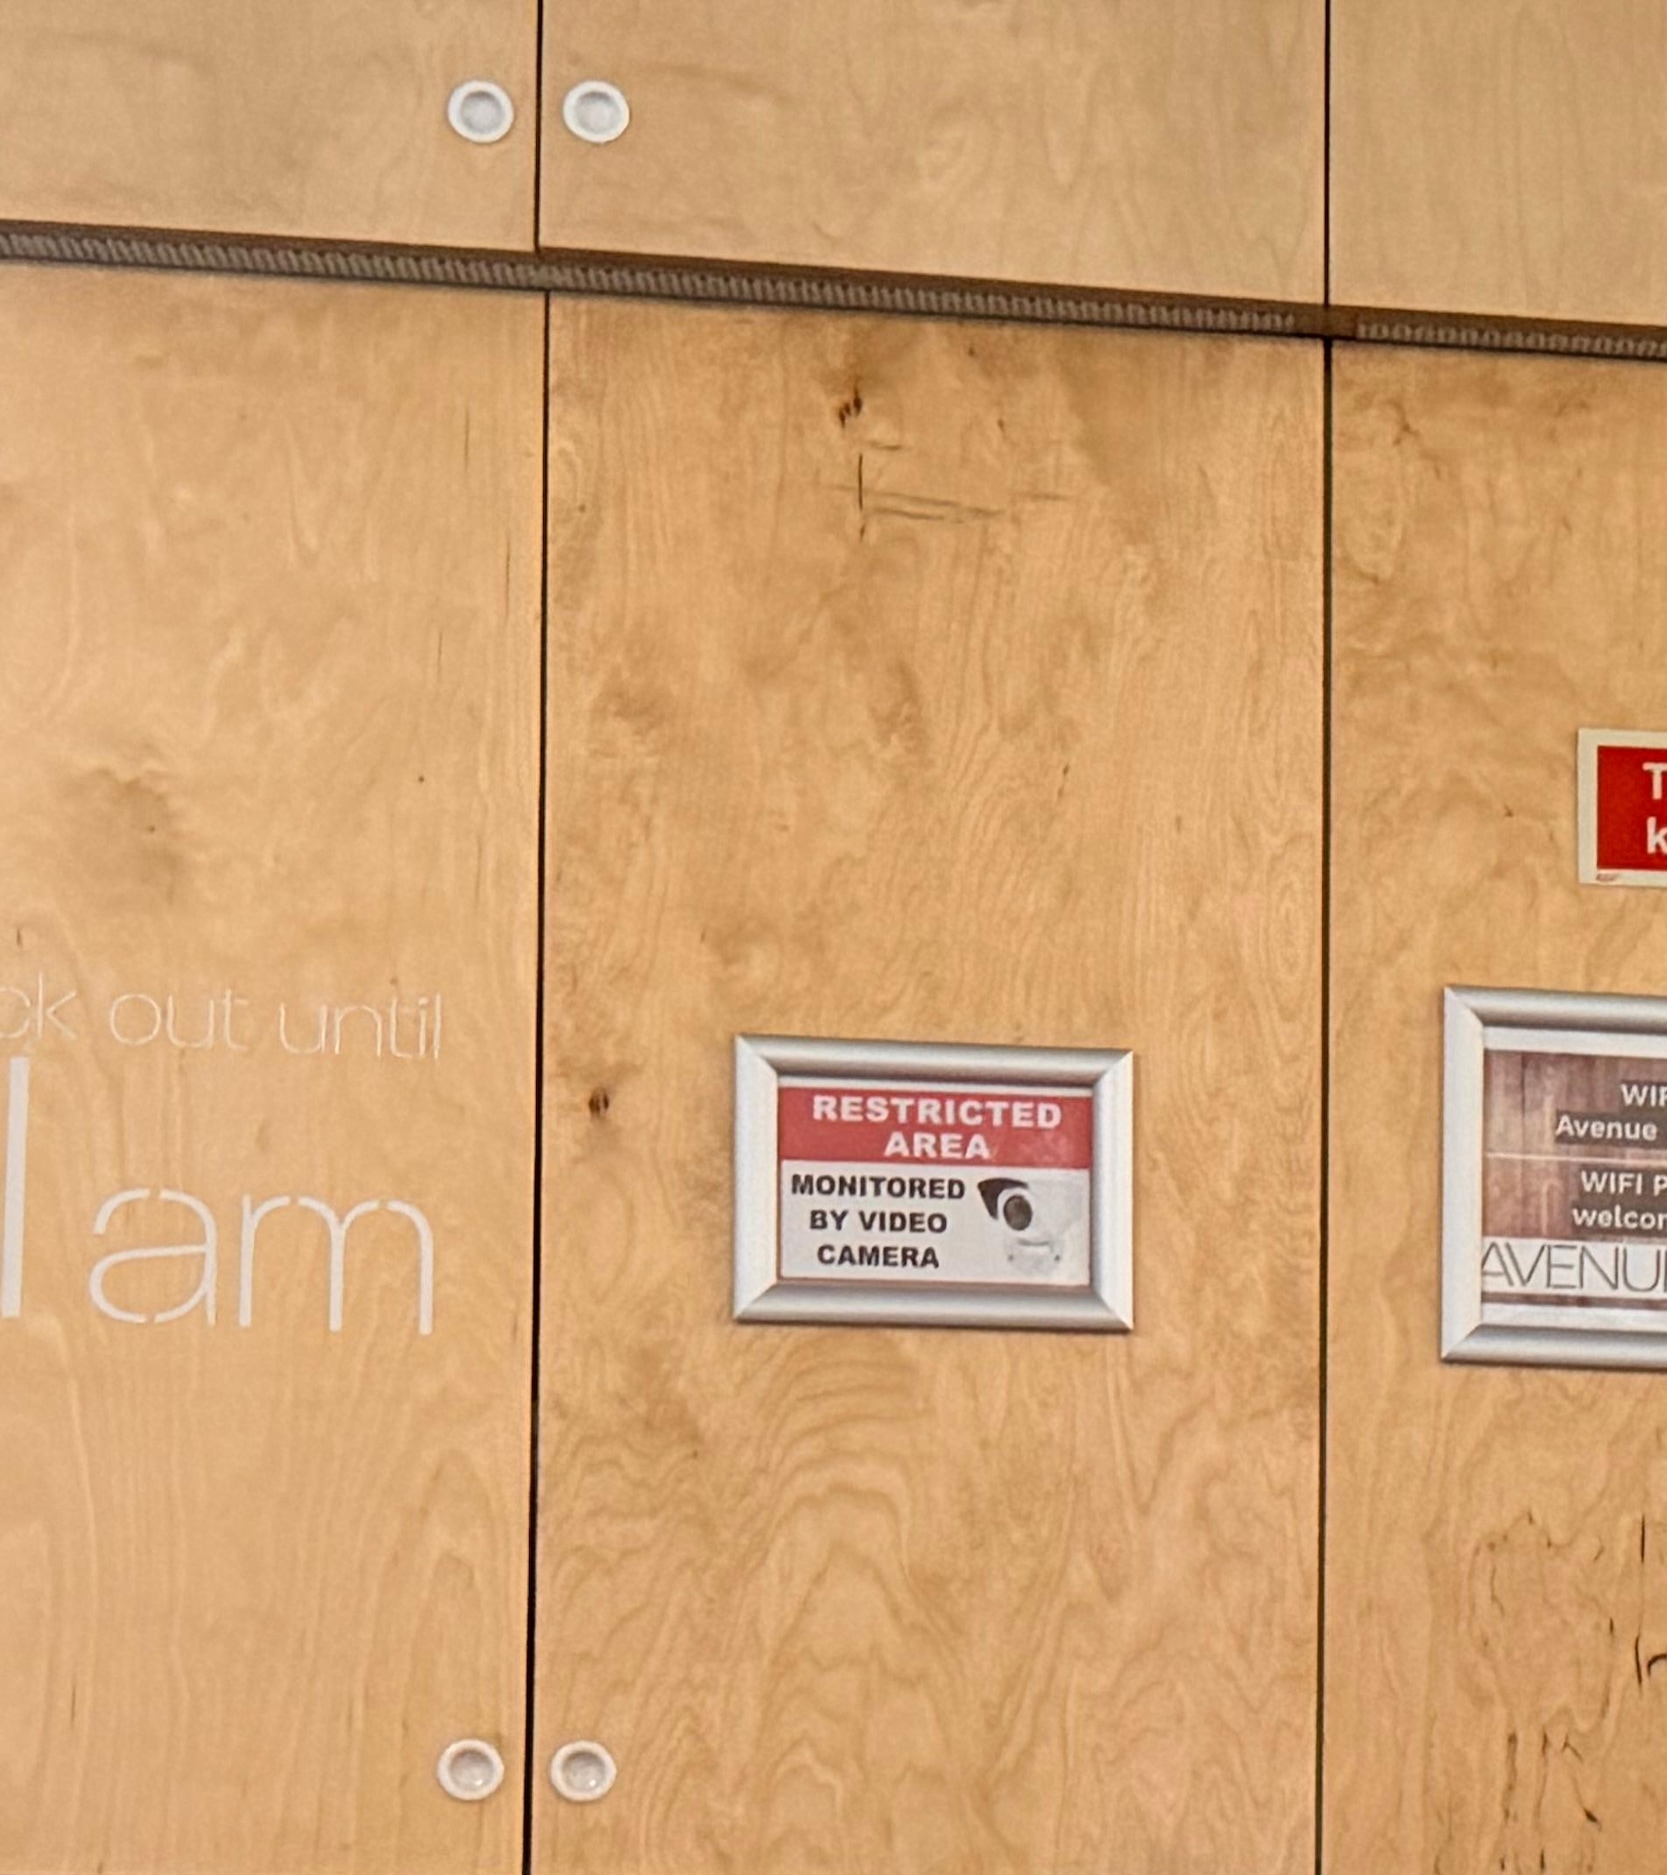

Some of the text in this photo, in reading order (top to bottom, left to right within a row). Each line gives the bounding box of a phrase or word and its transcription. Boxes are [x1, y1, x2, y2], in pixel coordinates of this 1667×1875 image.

[109, 988, 247, 1051] out
[279, 993, 442, 1060] until
[812, 1094, 1062, 1130] RESTRICTED
[1556, 1114, 1658, 1142] Avenue
[883, 1132, 991, 1160] AREA
[790, 1173, 966, 1200] MONITORED
[1581, 1170, 1643, 1195] WIFI
[810, 1210, 948, 1235] BY VIDEO
[88, 1188, 433, 1337] am
[817, 1244, 940, 1270] CAMERA
